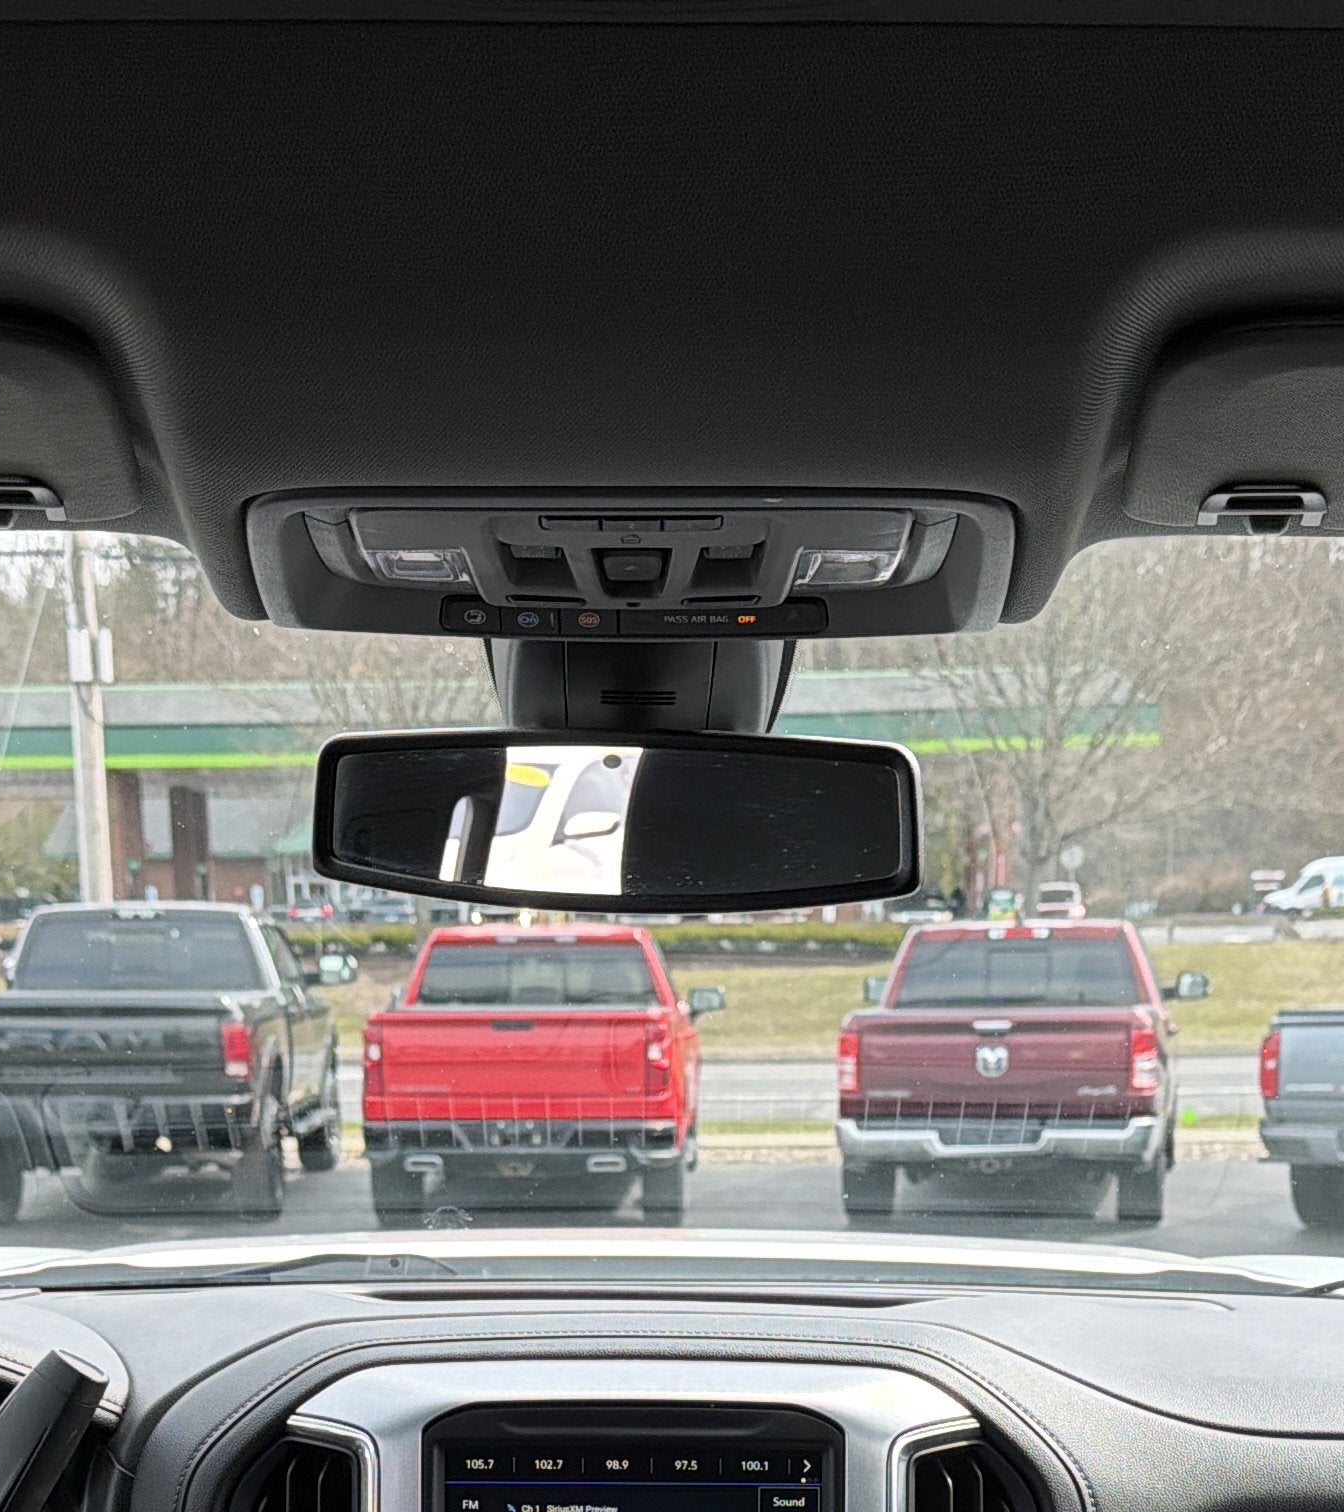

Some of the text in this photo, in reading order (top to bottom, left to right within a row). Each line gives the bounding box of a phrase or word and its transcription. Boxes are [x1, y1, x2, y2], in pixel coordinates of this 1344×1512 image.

[663, 615, 757, 624] PASS AIR BAG OFF
[465, 1460, 769, 1471] 105.7 102.7 98.9 97.5 100.1
[462, 1500, 479, 1510] FM
[772, 1497, 806, 1508] Sound
